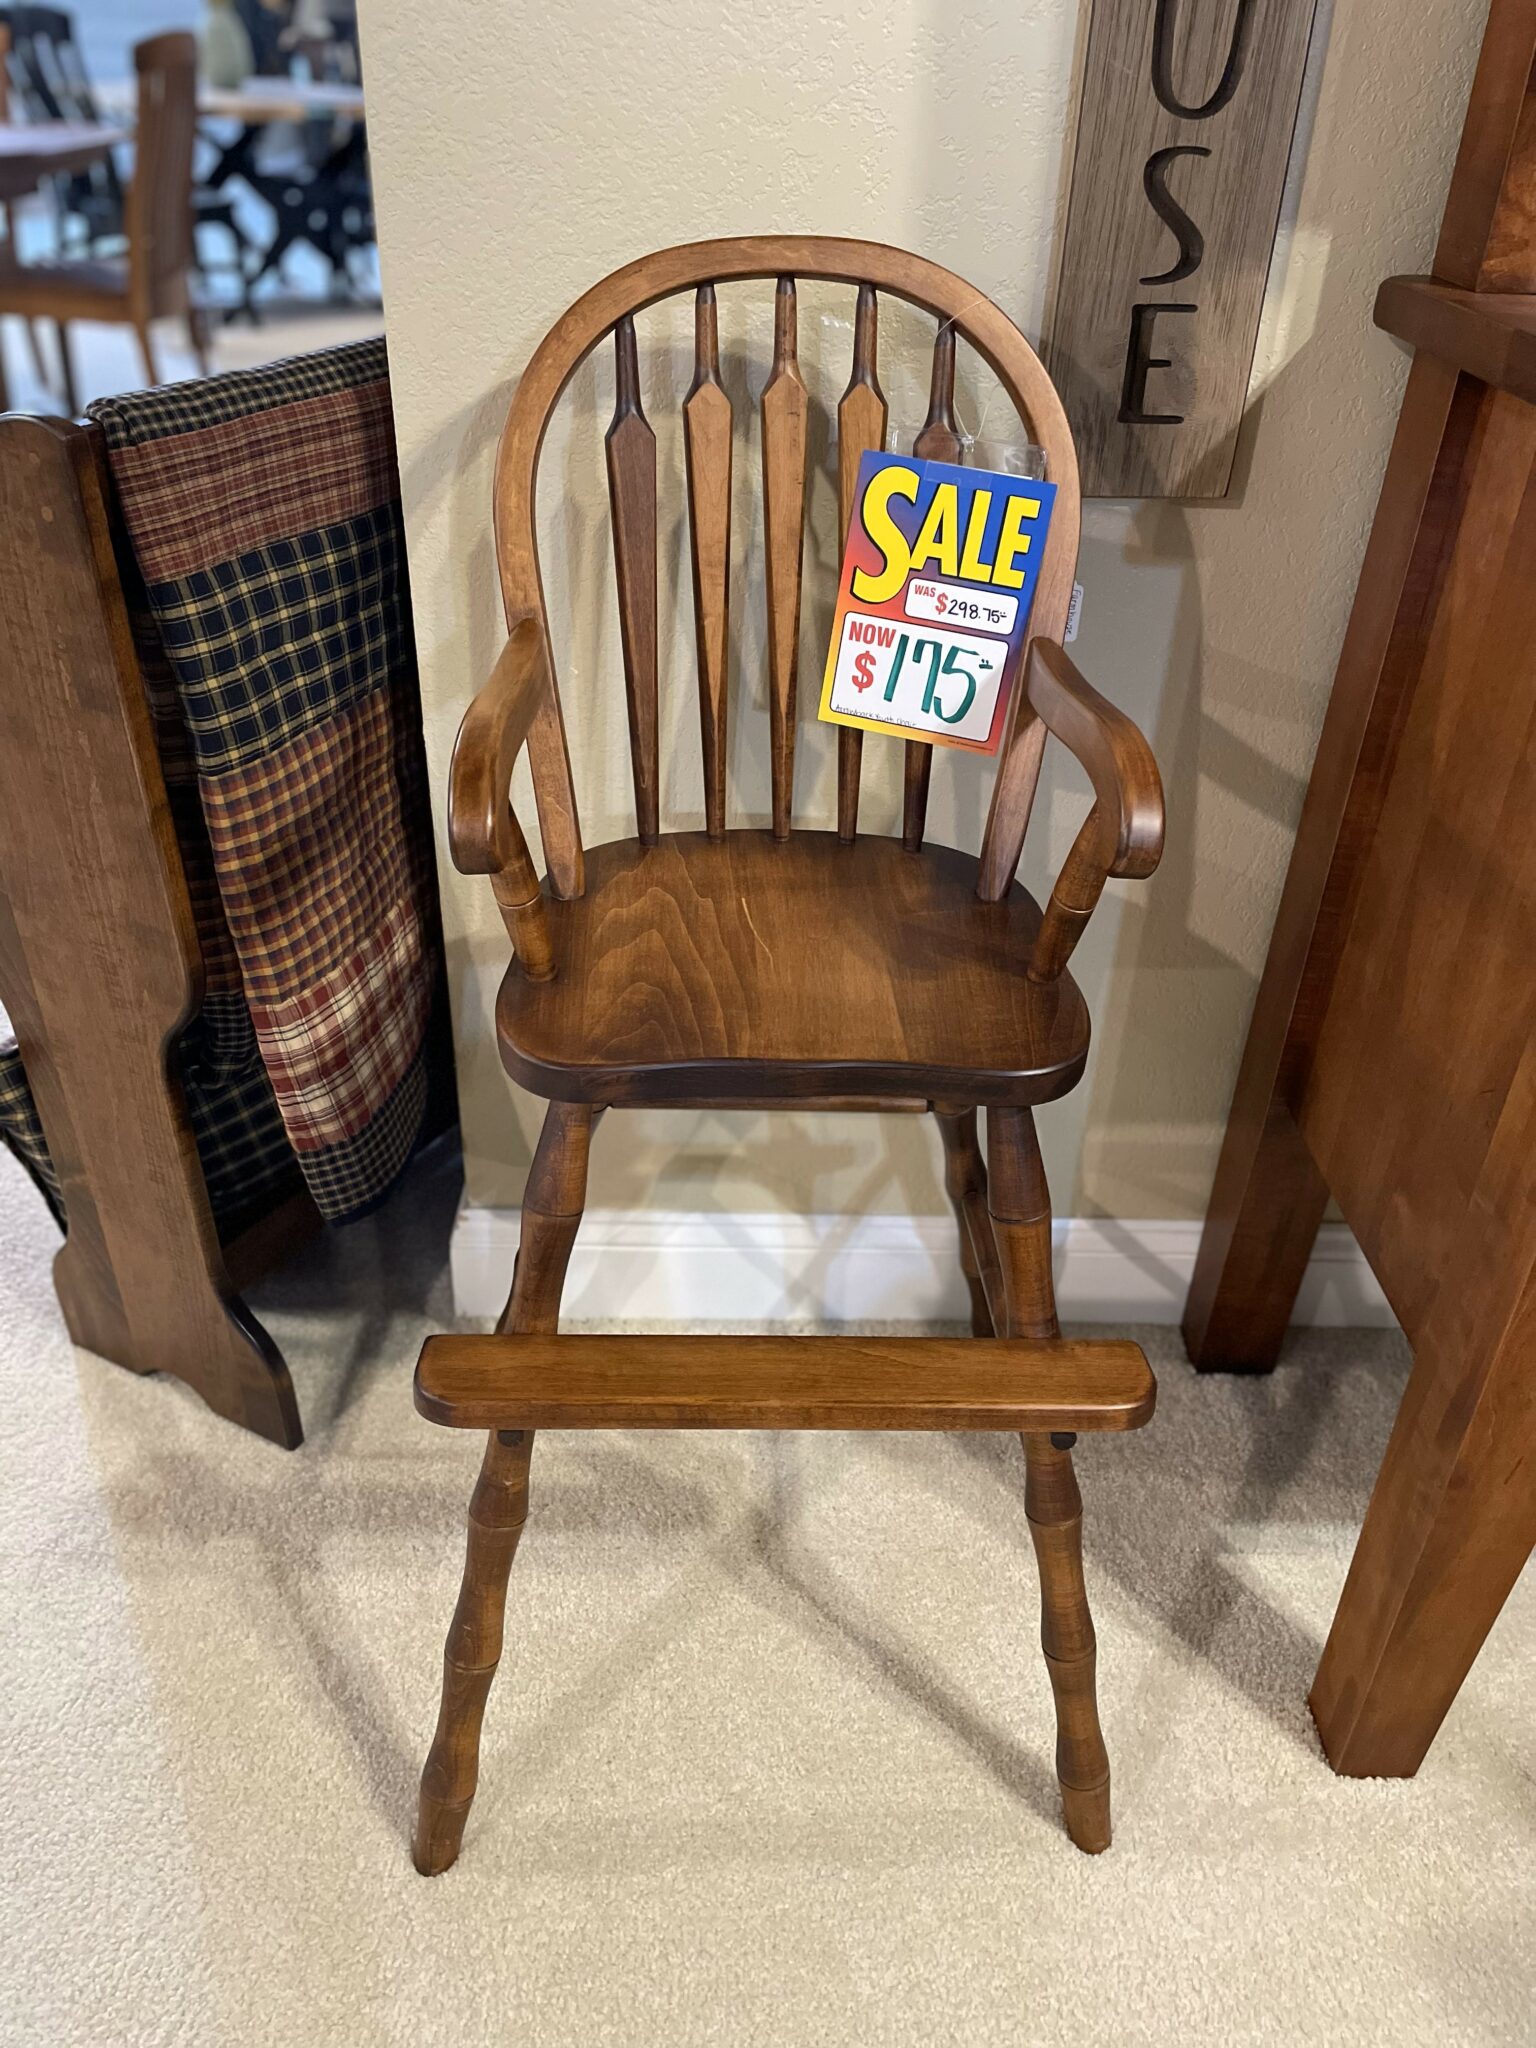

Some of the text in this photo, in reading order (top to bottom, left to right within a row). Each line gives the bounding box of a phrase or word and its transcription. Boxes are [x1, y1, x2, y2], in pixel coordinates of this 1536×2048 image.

[851, 466, 1042, 604] SALE
[914, 584, 936, 598] WAS
[848, 621, 896, 648] NOW
